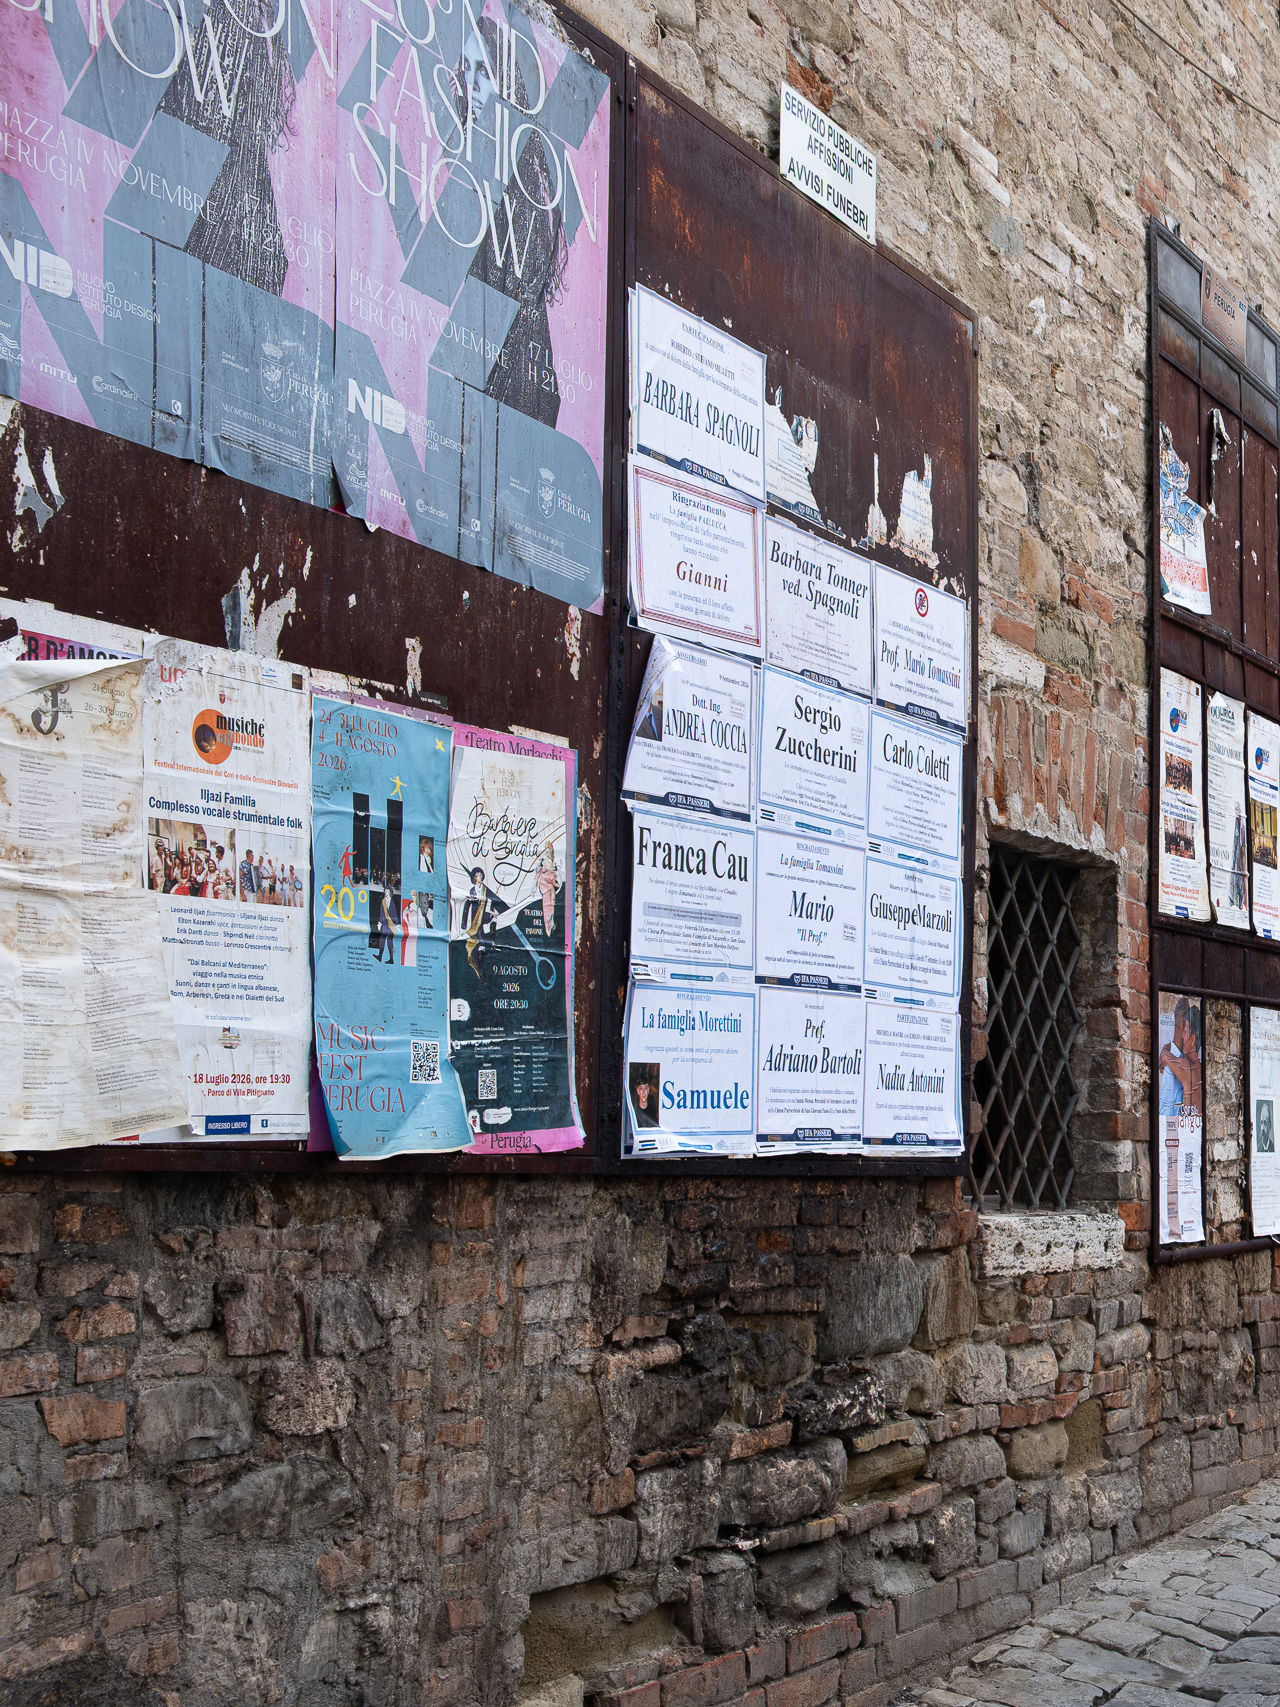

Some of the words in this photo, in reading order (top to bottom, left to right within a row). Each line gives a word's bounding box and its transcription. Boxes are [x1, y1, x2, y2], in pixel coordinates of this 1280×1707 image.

[370, 18, 597, 243] FASHION
[784, 91, 826, 138] SERVIZIO
[828, 124, 873, 178] PUBBLICHE
[807, 134, 854, 185] AFFISSIONI
[77, 138, 95, 165] IV
[103, 148, 217, 224] NOVEMBRE
[348, 102, 537, 279] SHOW
[788, 157, 824, 197] AVVISI
[826, 184, 869, 233] FUNEBRI
[243, 193, 260, 218] 17
[266, 203, 333, 254] LUGLIO
[78, 269, 115, 293] NUOVO
[1216, 278, 1231, 299] Comune
[1232, 294, 1237, 303] di
[78, 281, 122, 308] ISTITUTO
[124, 300, 161, 324] DESIGN
[78, 295, 123, 321] PERUGIA
[1213, 292, 1236, 321] PERUGIA
[350, 267, 405, 317] PIAZZA
[410, 299, 423, 322] IV
[428, 309, 509, 370] NOVEMBRE
[350, 294, 417, 345] PERUGIA
[528, 341, 541, 359] 17
[545, 349, 593, 392] LUGLIO
[91, 375, 139, 401] Cardinalini
[528, 365, 537, 384] H
[542, 370, 576, 403] 21.30
[348, 378, 405, 435] NID
[409, 409, 435, 429] NUOVO
[643, 371, 700, 428] BARBARA
[706, 402, 760, 458] SPAGNOLI
[441, 435, 466, 455] DESIGN
[416, 499, 449, 520] Cardinalini
[557, 499, 591, 524] PERUGIA
[669, 505, 676, 514] La
[676, 508, 698, 522] famiglia
[671, 490, 727, 518] Ringraziamento
[676, 560, 728, 593] Gianni
[769, 539, 822, 581] Barbara
[826, 563, 868, 599] Tonner
[782, 578, 803, 599] ved.
[805, 580, 859, 620] Spagnoli
[880, 639, 900, 673] Prof.
[903, 648, 926, 677] Mario
[927, 657, 961, 690] Tomassini
[91, 682, 99, 691] 21
[100, 686, 125, 698] giugno
[692, 694, 708, 711] Dott.
[709, 699, 723, 716] Ing.
[107, 707, 133, 720] giugno
[216, 713, 265, 737] musiche
[319, 708, 331, 724] 24
[340, 713, 349, 728] 31
[351, 715, 398, 739] LUGLIO
[794, 694, 841, 735] Sergio
[233, 731, 265, 748] mondo
[318, 729, 324, 742] 4
[335, 732, 343, 747] 11
[348, 734, 396, 758] AGOSTO
[467, 731, 505, 752] Teatro
[509, 740, 562, 761] Morlacchi
[663, 708, 707, 743] ANDREA
[710, 719, 747, 754] COCCIA
[317, 752, 347, 771] 2026
[774, 726, 858, 774] Zuccherini
[883, 733, 914, 770] Carlo
[916, 745, 950, 782] Coletti
[154, 759, 176, 770] Festival
[176, 763, 214, 777] Internazionale
[215, 769, 223, 778] dei
[223, 770, 234, 779] Cori
[239, 773, 252, 782] delle
[252, 775, 277, 787] Orchestre
[277, 779, 299, 790] Giovanili
[148, 796, 200, 818] Complesso
[202, 806, 231, 819] vocale
[233, 809, 285, 827] strumentale
[286, 817, 303, 830] folk
[224, 792, 256, 808] Familia
[677, 794, 687, 803] IFA
[686, 796, 711, 809] PASSERI
[467, 796, 539, 839] Barbiere
[472, 835, 489, 857] di
[637, 826, 707, 876] Franca
[711, 840, 749, 882] Cau
[780, 853, 789, 866] La
[788, 856, 815, 872] famiglia
[815, 859, 844, 876] Tomassini
[524, 909, 543, 917] TEATRO
[788, 890, 834, 923] Mario
[192, 970, 213, 979] viaggio
[493, 965, 498, 975] 9
[498, 965, 528, 976] AGOSTO
[502, 982, 520, 992] 2026
[493, 999, 510, 1009] ORE
[510, 999, 529, 1009] 20:30
[641, 1006, 655, 1029] La
[657, 1007, 697, 1036] famiglia
[698, 1010, 742, 1033] Morettini
[804, 1018, 826, 1044] Prof.
[317, 1021, 386, 1052] MUSIC
[319, 1053, 367, 1081] FEST
[762, 1043, 818, 1074] Adriano
[820, 1047, 862, 1075] Bartoli
[193, 1073, 204, 1084] 18
[205, 1074, 229, 1086] Luglio
[231, 1074, 253, 1086] 2026,
[255, 1076, 267, 1084] ore
[269, 1074, 291, 1084] 19:30
[207, 1088, 225, 1096] Parco
[226, 1088, 232, 1096] di
[246, 1089, 275, 1097] Pitignano
[876, 1063, 906, 1092] Nadia
[906, 1066, 945, 1094] Antonini
[661, 1080, 750, 1110] Samuele
[207, 1122, 231, 1130] INGRESSO
[231, 1121, 248, 1129] LIBERO
[490, 1133, 532, 1152] Perugia
